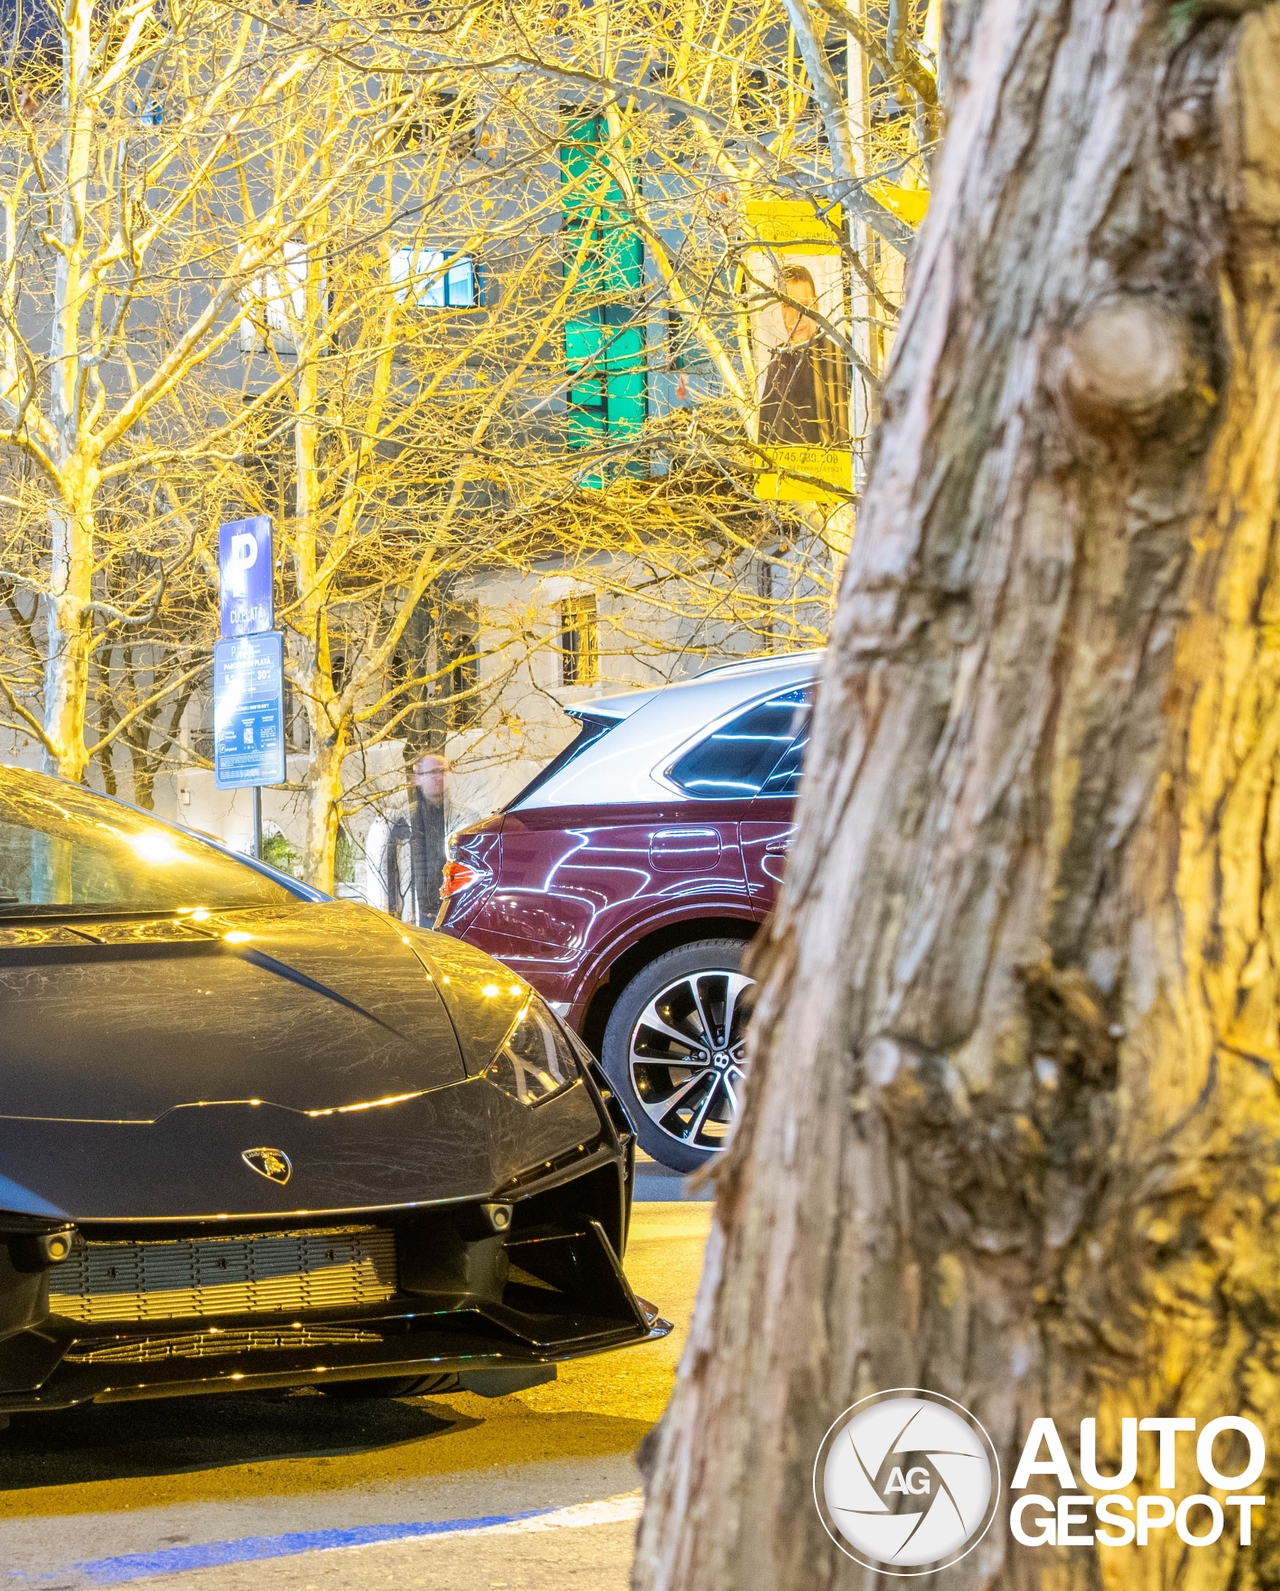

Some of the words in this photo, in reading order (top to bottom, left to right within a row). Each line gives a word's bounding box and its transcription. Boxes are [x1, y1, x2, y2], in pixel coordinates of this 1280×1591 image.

[231, 532, 258, 598] P
[230, 609, 240, 624] CU
[255, 656, 271, 667] PLATĂ
